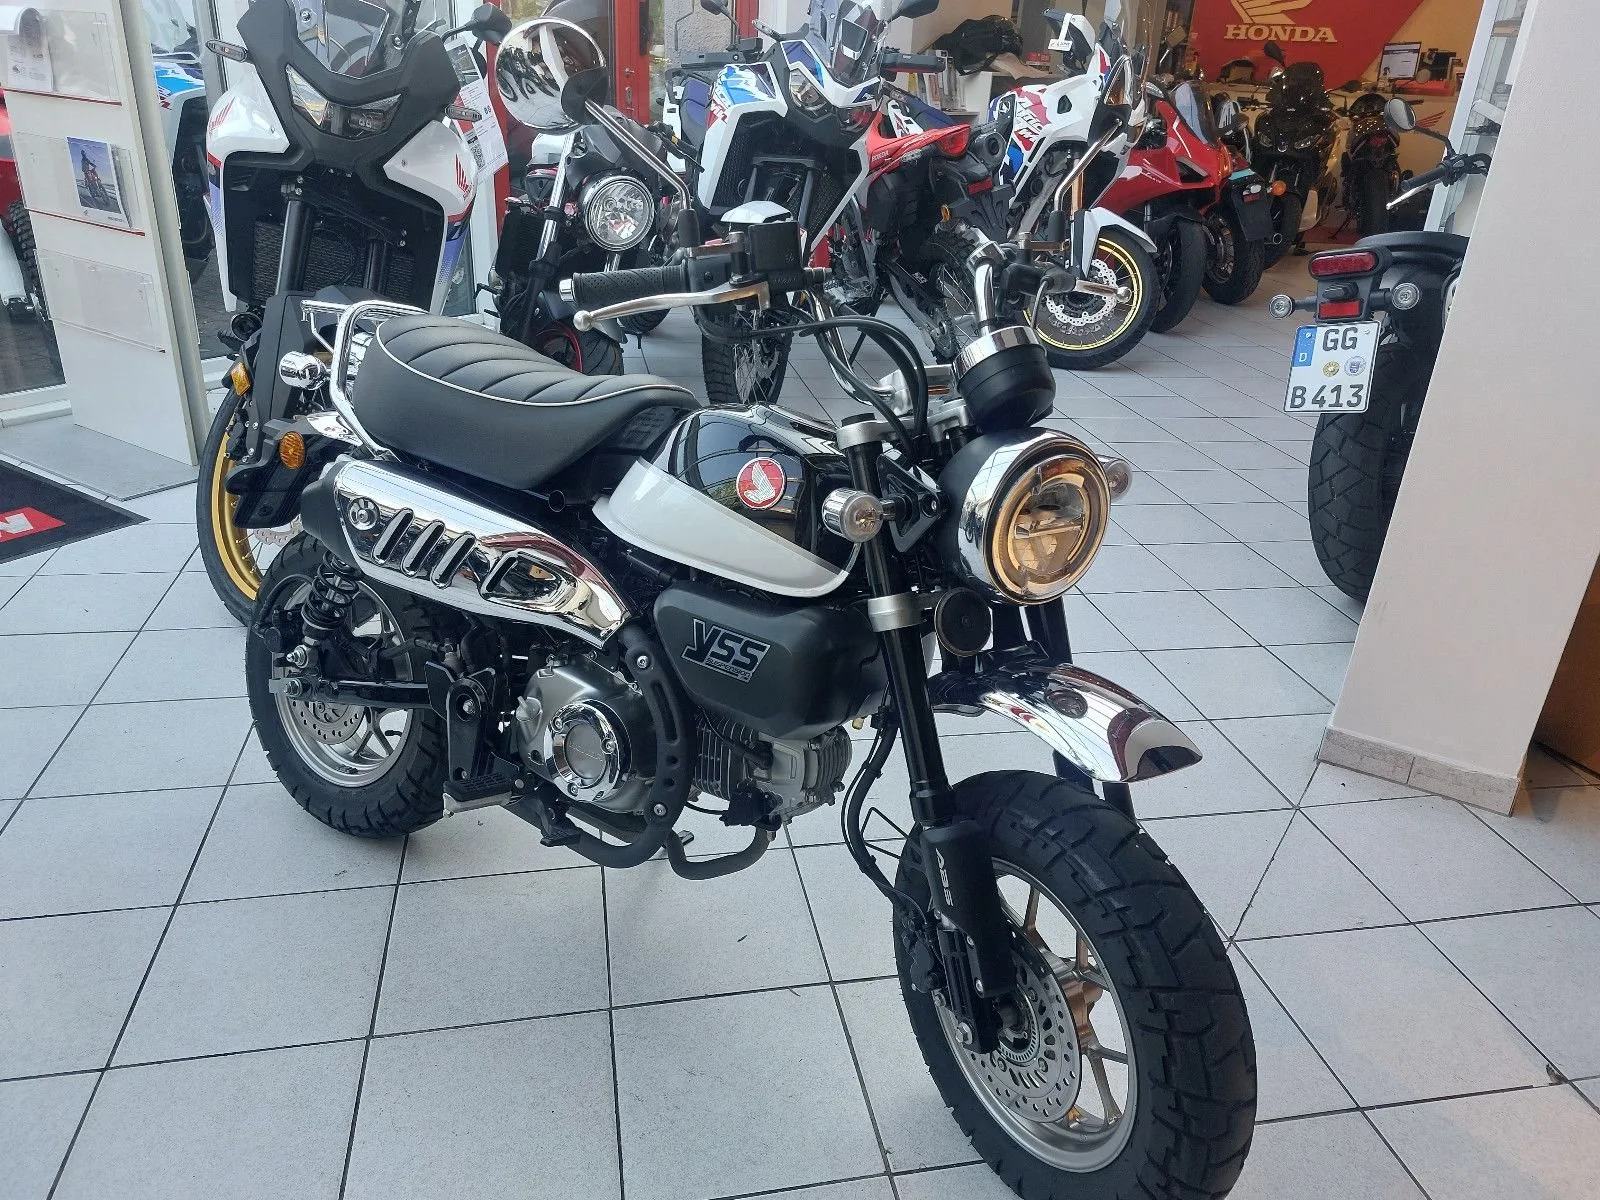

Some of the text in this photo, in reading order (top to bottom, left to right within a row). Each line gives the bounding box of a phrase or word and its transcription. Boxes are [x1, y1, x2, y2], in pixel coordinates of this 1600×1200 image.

[1223, 24, 1338, 43] HONDA
[1322, 326, 1359, 352] GG
[1299, 352, 1308, 362] D
[1289, 383, 1365, 409] B 413
[681, 618, 771, 673] YSS
[935, 847, 954, 907] ABS
